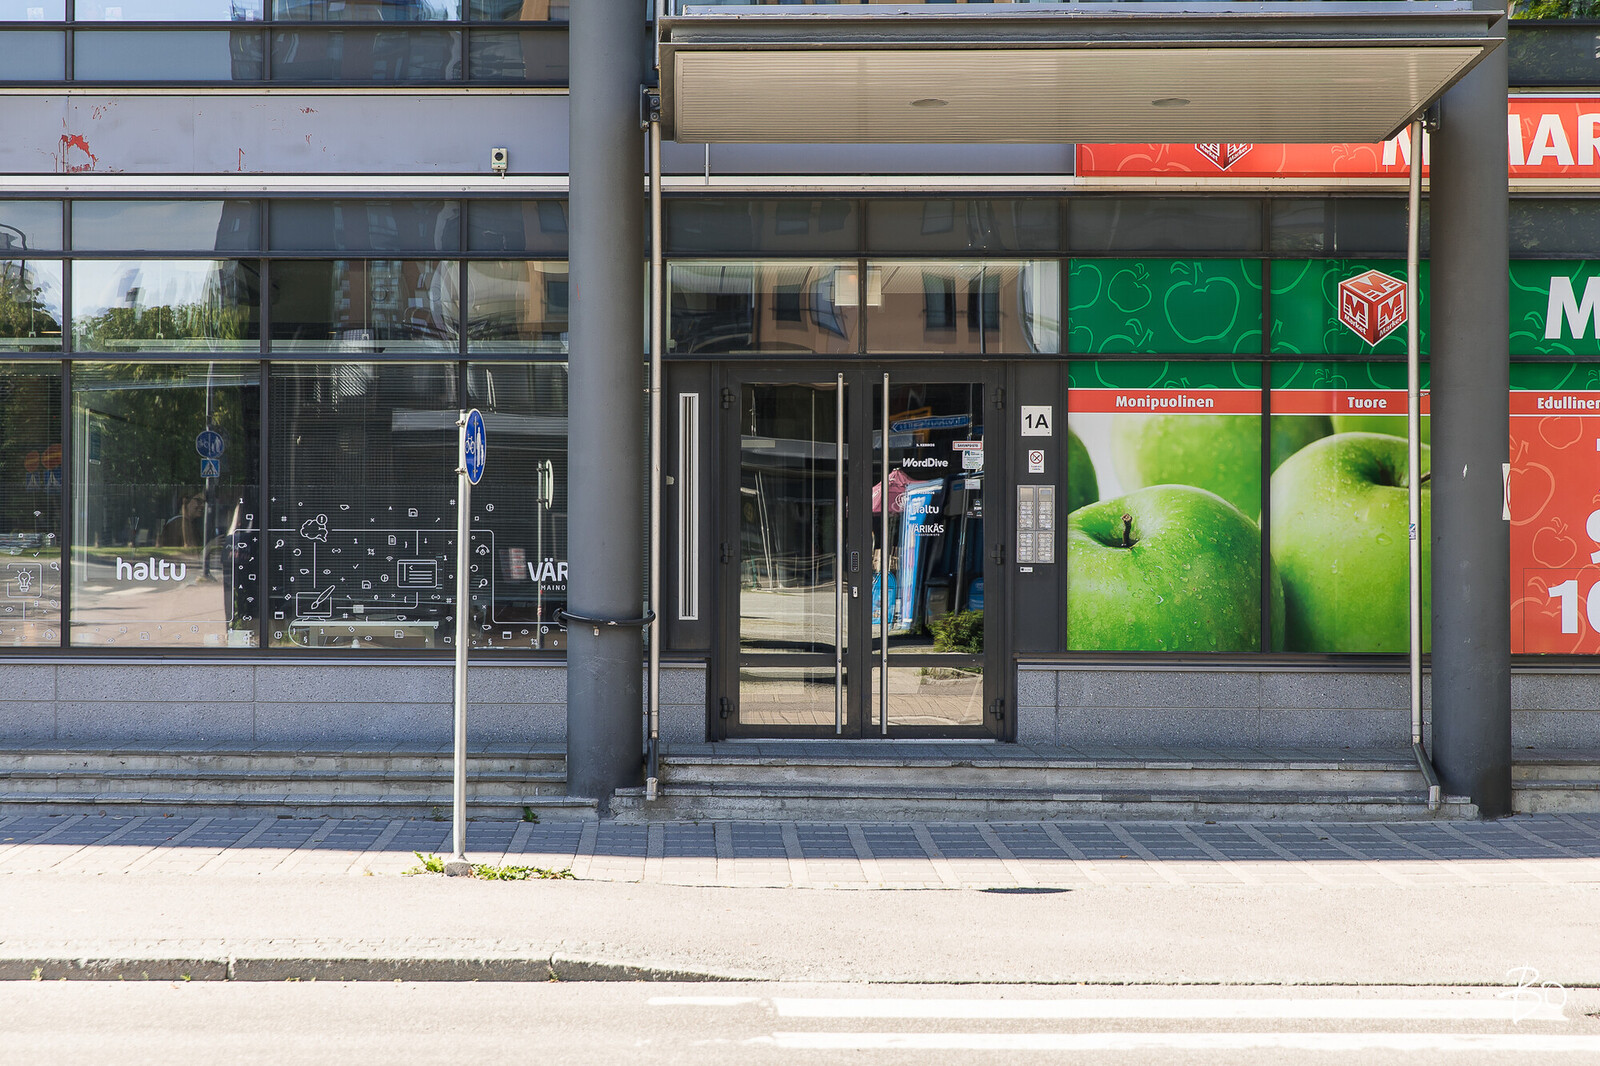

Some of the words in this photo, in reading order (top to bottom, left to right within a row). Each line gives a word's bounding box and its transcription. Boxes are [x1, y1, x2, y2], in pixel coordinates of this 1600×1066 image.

[1344, 314, 1366, 335] Market
[1379, 315, 1402, 337] Market
[1115, 395, 1214, 410] Monipuolinen
[1347, 397, 1387, 408] Tuore
[1025, 414, 1049, 428] 1A
[902, 457, 948, 467] WordDive
[116, 557, 186, 580] haltu
